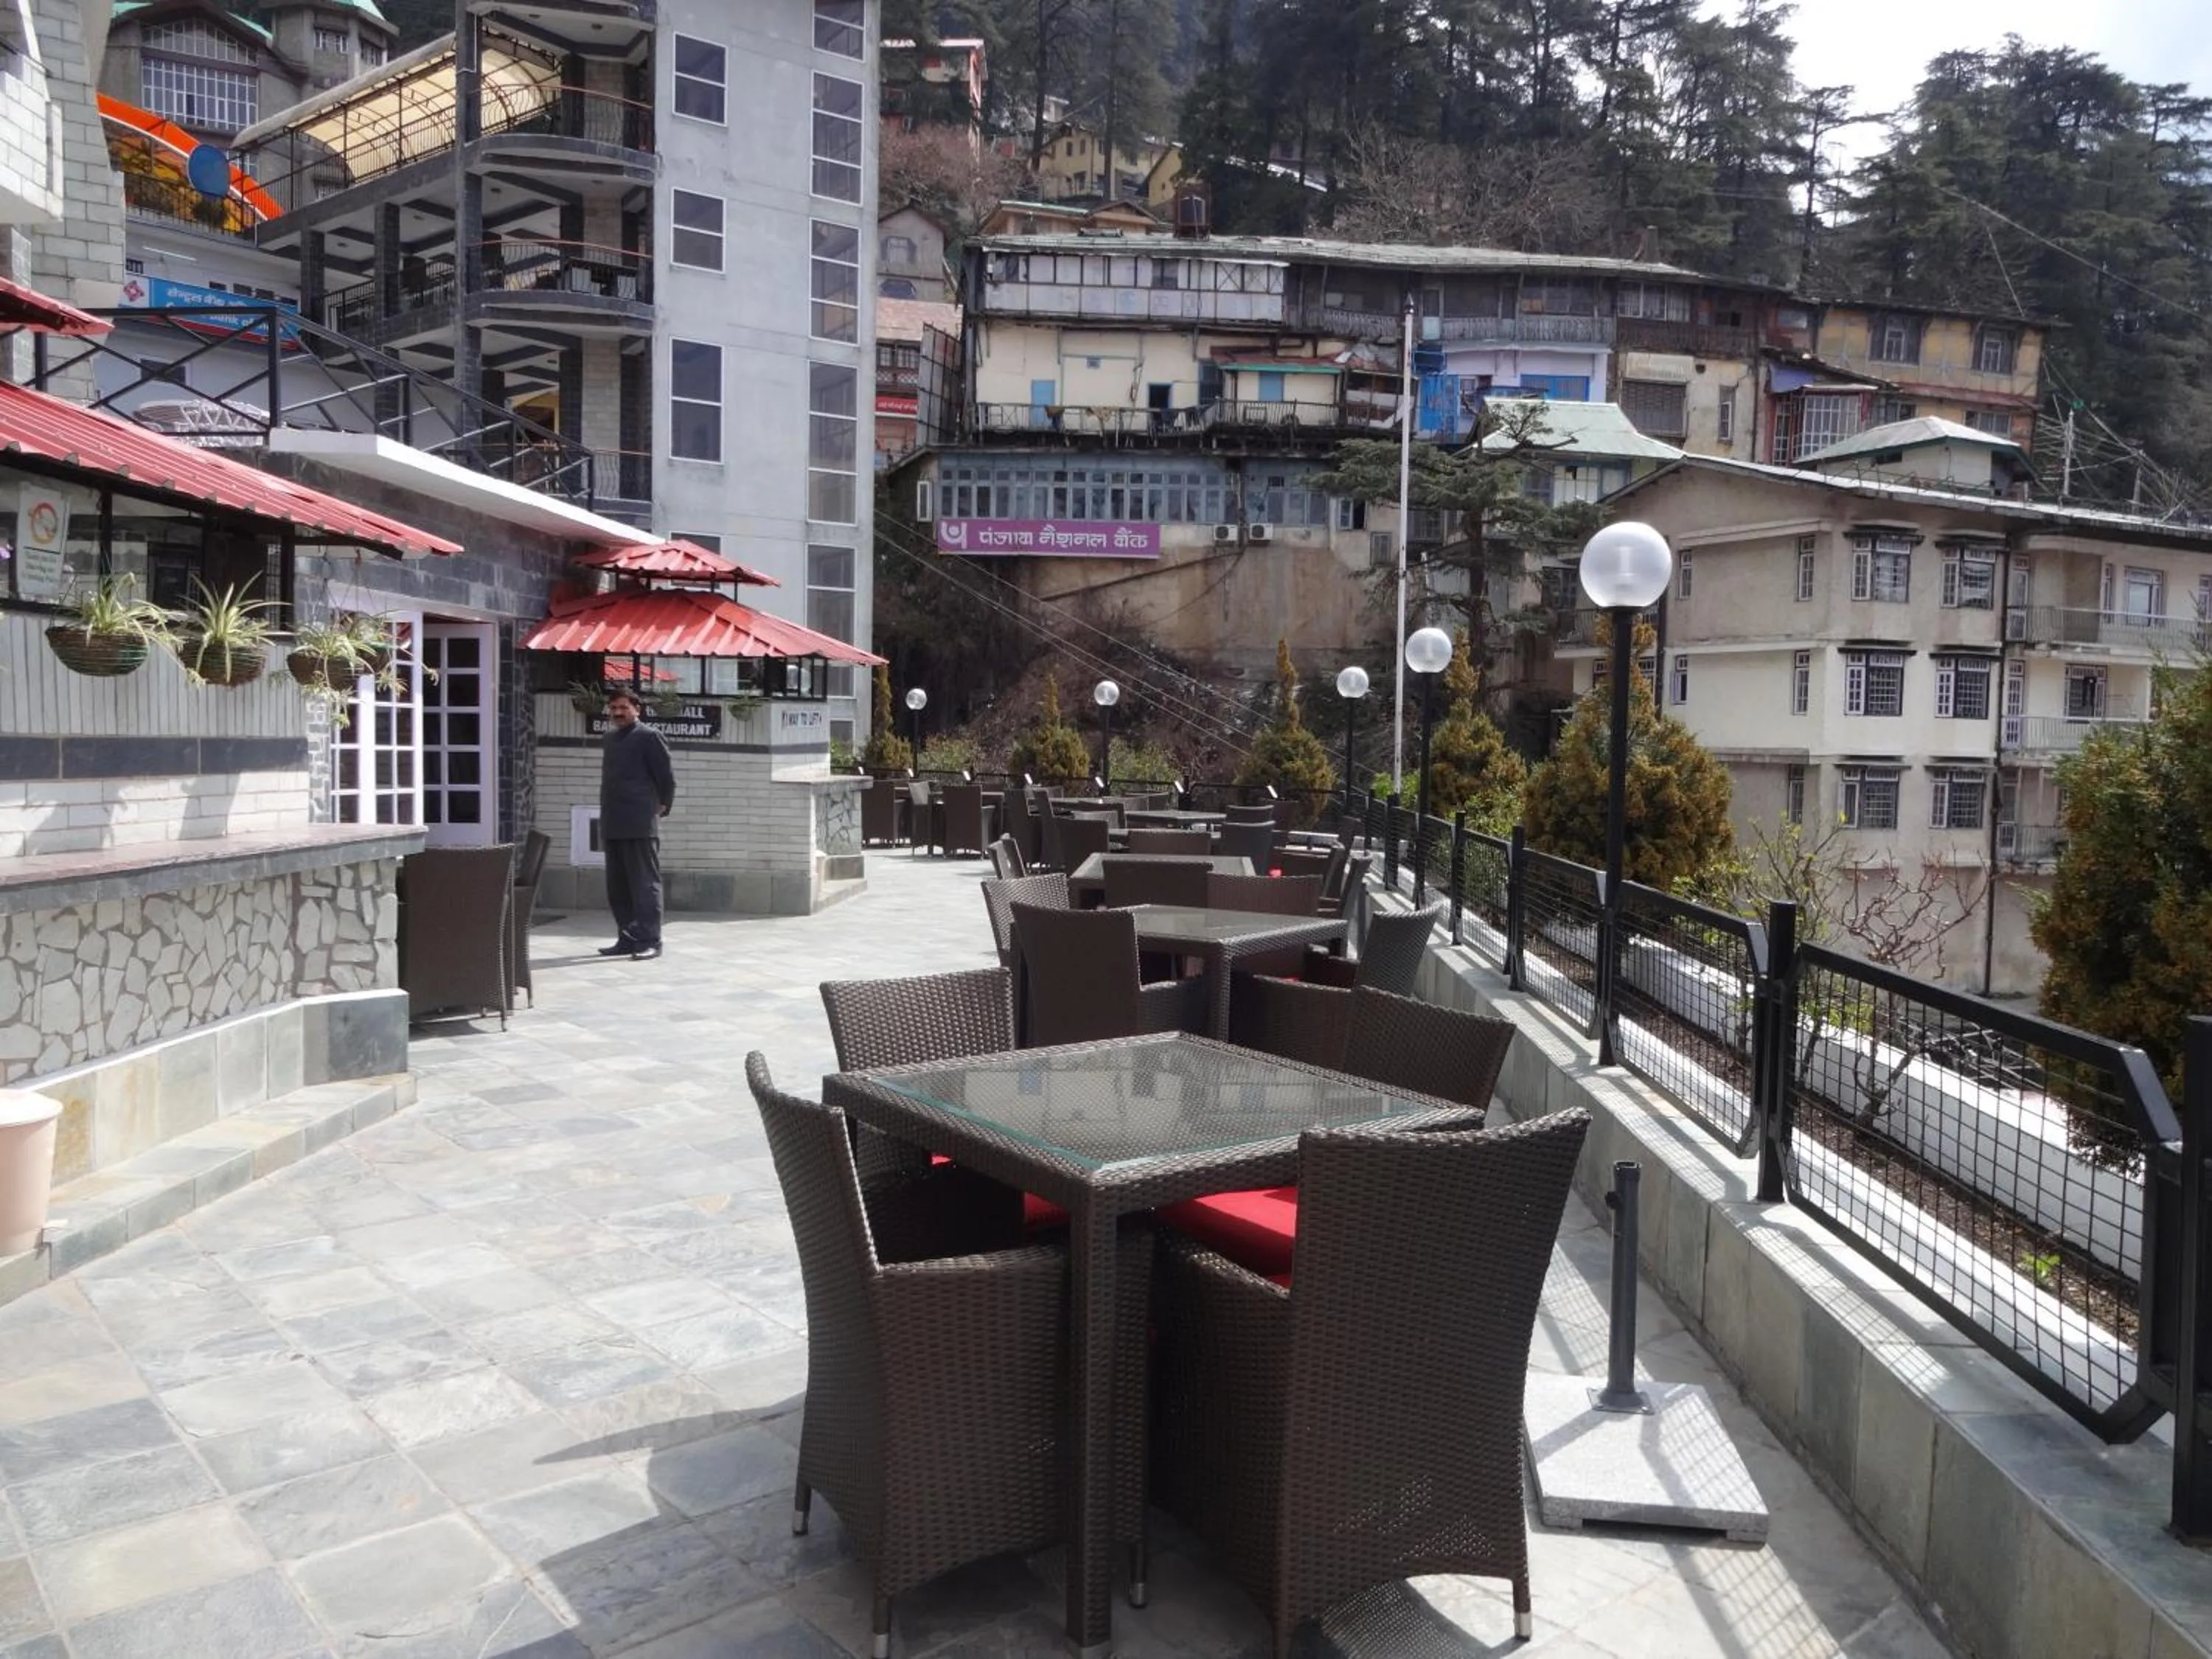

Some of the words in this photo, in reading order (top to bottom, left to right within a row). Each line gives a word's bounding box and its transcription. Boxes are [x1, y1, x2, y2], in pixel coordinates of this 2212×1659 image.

[979, 526, 1032, 546] पंजाब
[1038, 524, 1106, 549] नैशनल
[1113, 527, 1148, 549] बैंक
[678, 706, 705, 719] ALL
